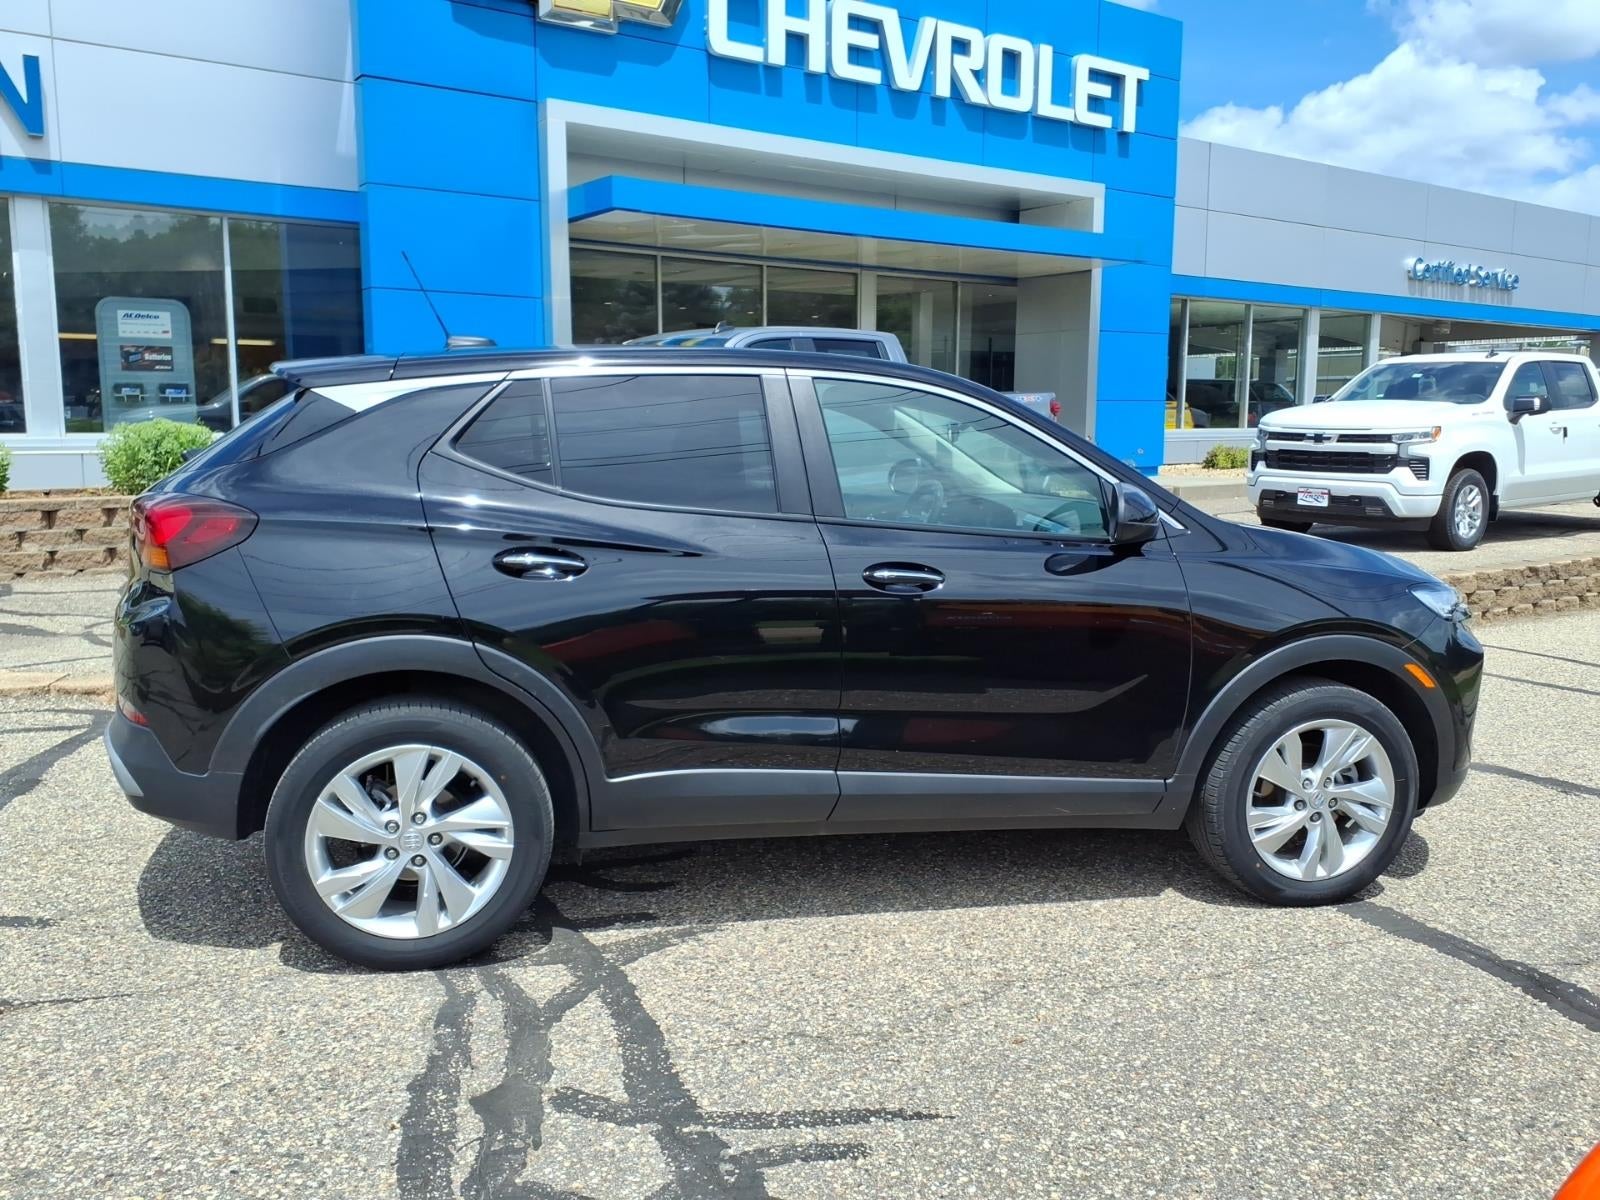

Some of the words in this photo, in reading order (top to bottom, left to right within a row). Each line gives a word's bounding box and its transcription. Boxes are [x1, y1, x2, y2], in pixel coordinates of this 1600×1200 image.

[705, 0, 1150, 134] CHEVROLET
[1411, 257, 1472, 286] Certified
[1474, 265, 1519, 291] Service
